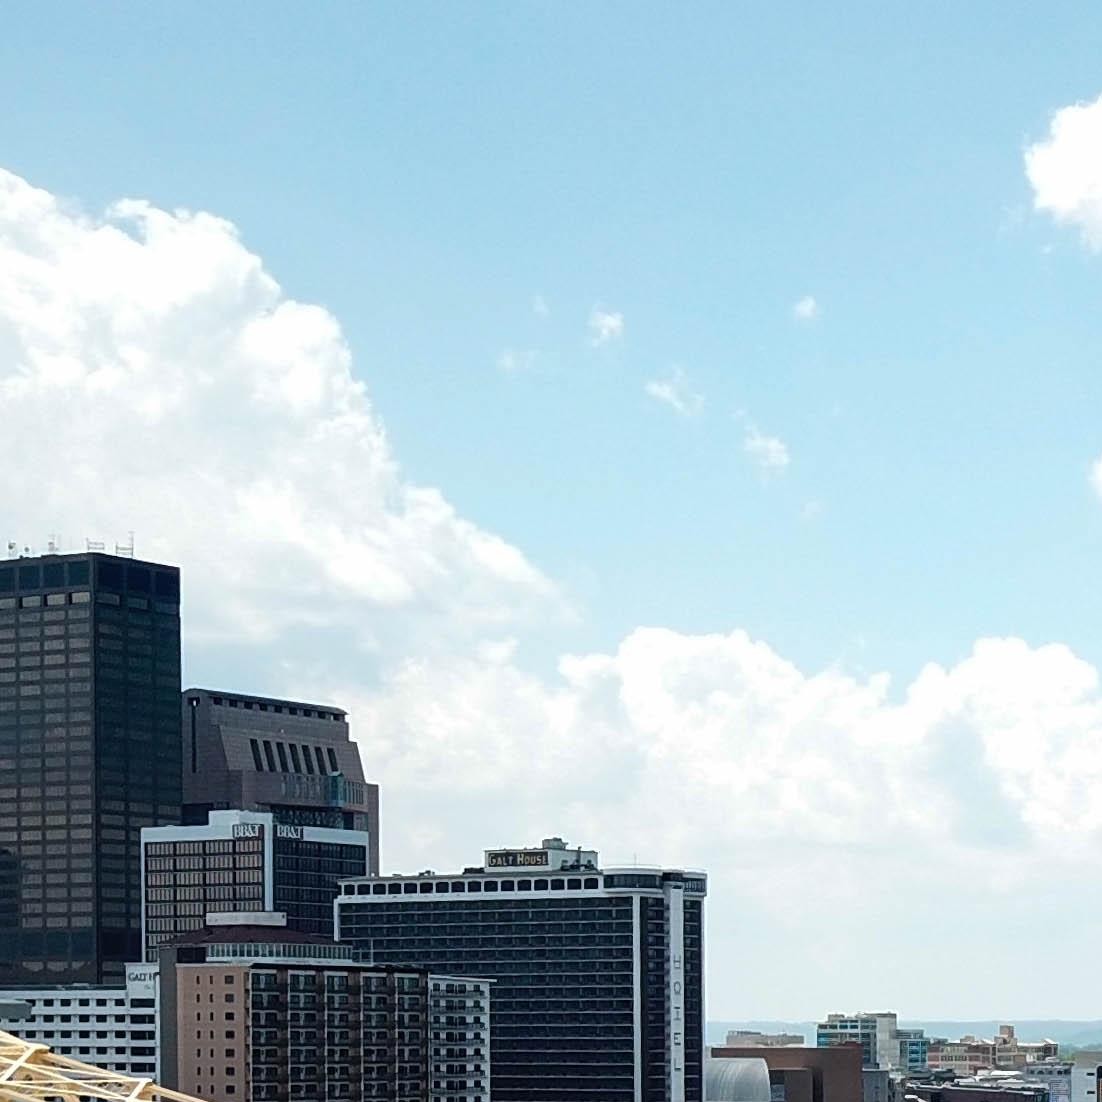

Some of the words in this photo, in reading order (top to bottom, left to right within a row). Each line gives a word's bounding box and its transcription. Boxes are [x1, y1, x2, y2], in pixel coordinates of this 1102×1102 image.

[234, 824, 261, 838] BB&T
[276, 824, 303, 839] BB&T
[490, 854, 514, 866] GALT
[516, 853, 547, 865] HOUSE
[673, 954, 681, 1072] HOTEL
